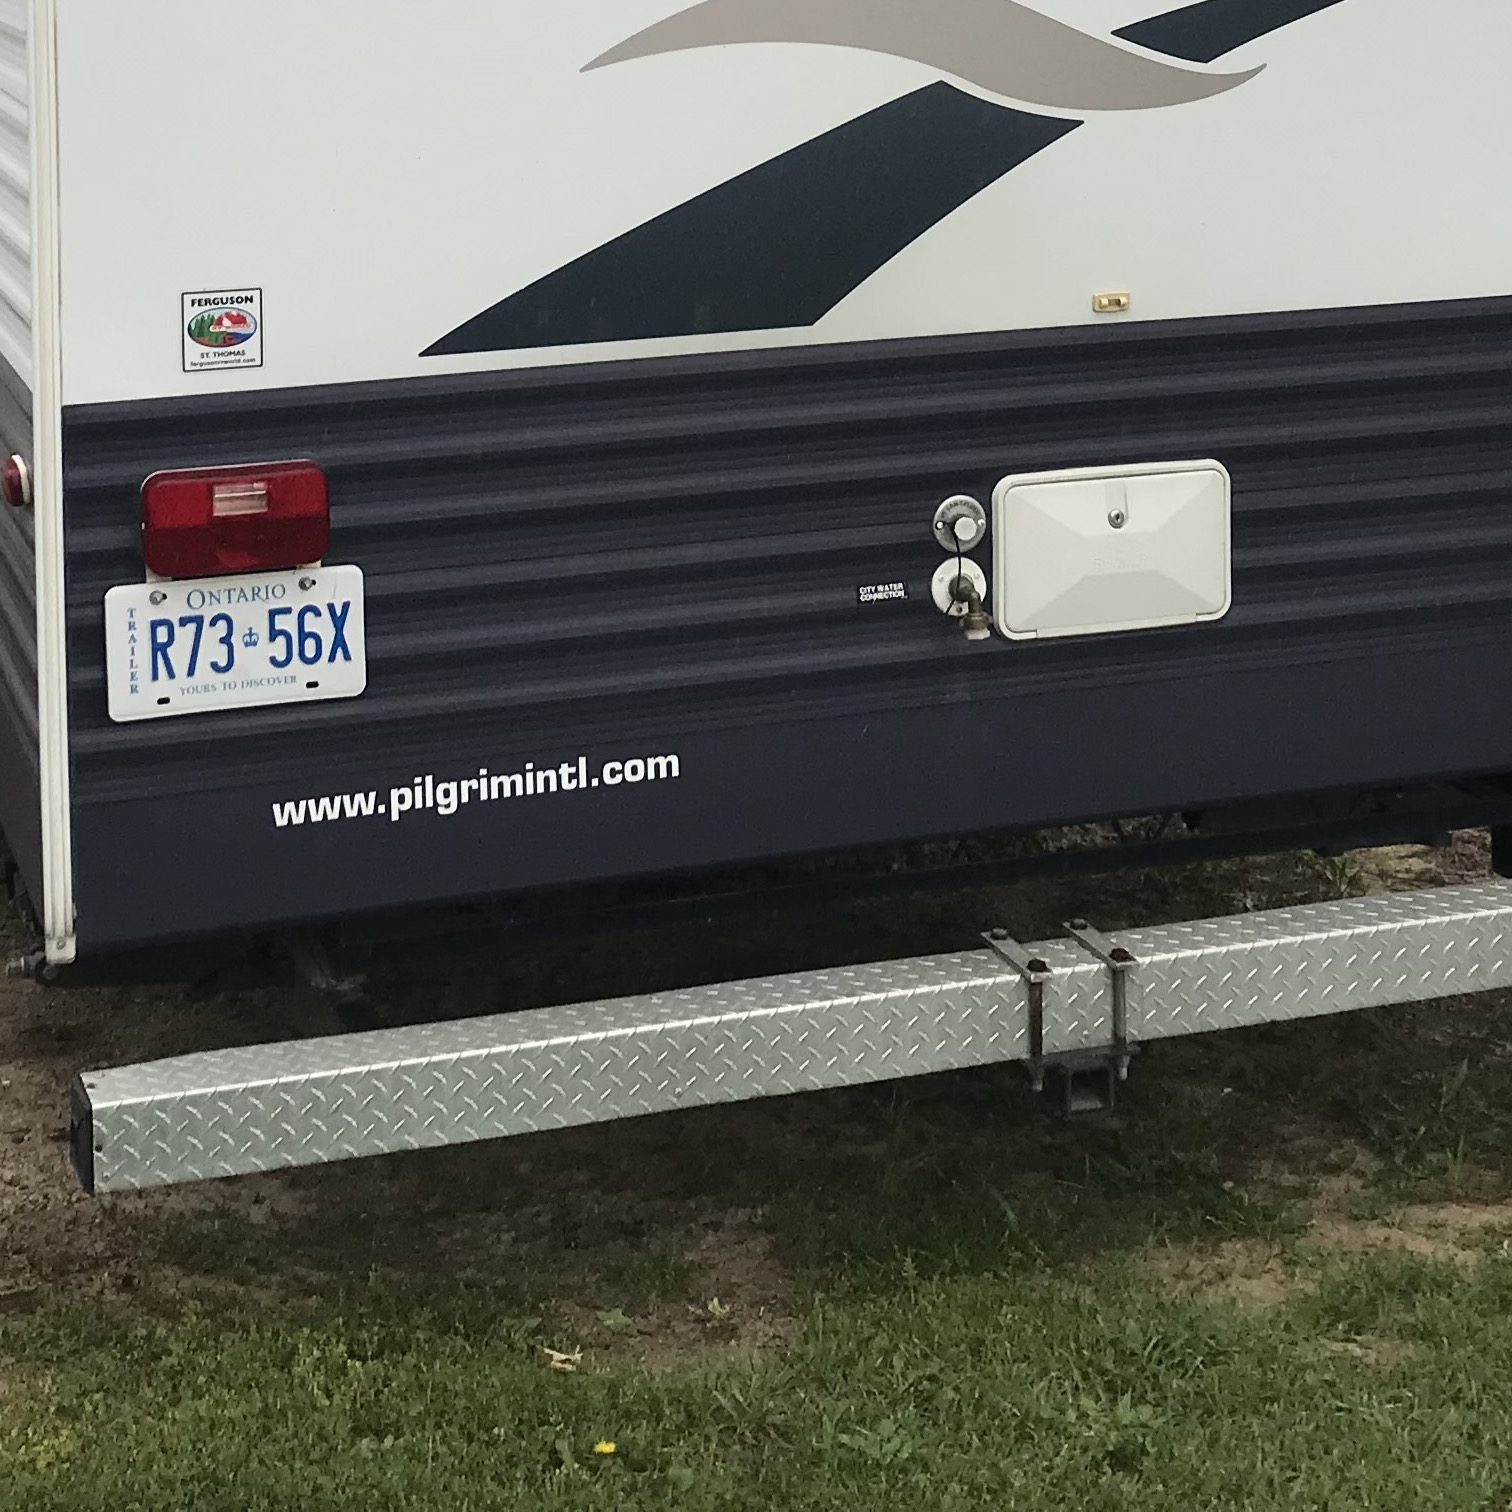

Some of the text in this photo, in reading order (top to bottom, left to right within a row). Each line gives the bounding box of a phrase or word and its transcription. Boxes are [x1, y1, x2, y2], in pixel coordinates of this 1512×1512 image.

[191, 295, 254, 307] FERGUSON
[213, 349, 246, 357] THOMAS
[859, 582, 904, 594] CITY WATER
[860, 590, 905, 601] CONNECTION
[149, 600, 352, 681] R73 56X
[127, 608, 139, 694] TRAILER
[180, 675, 297, 696] YOURS TO DISCOVER
[272, 753, 681, 827] www.pilgrimintl.com
